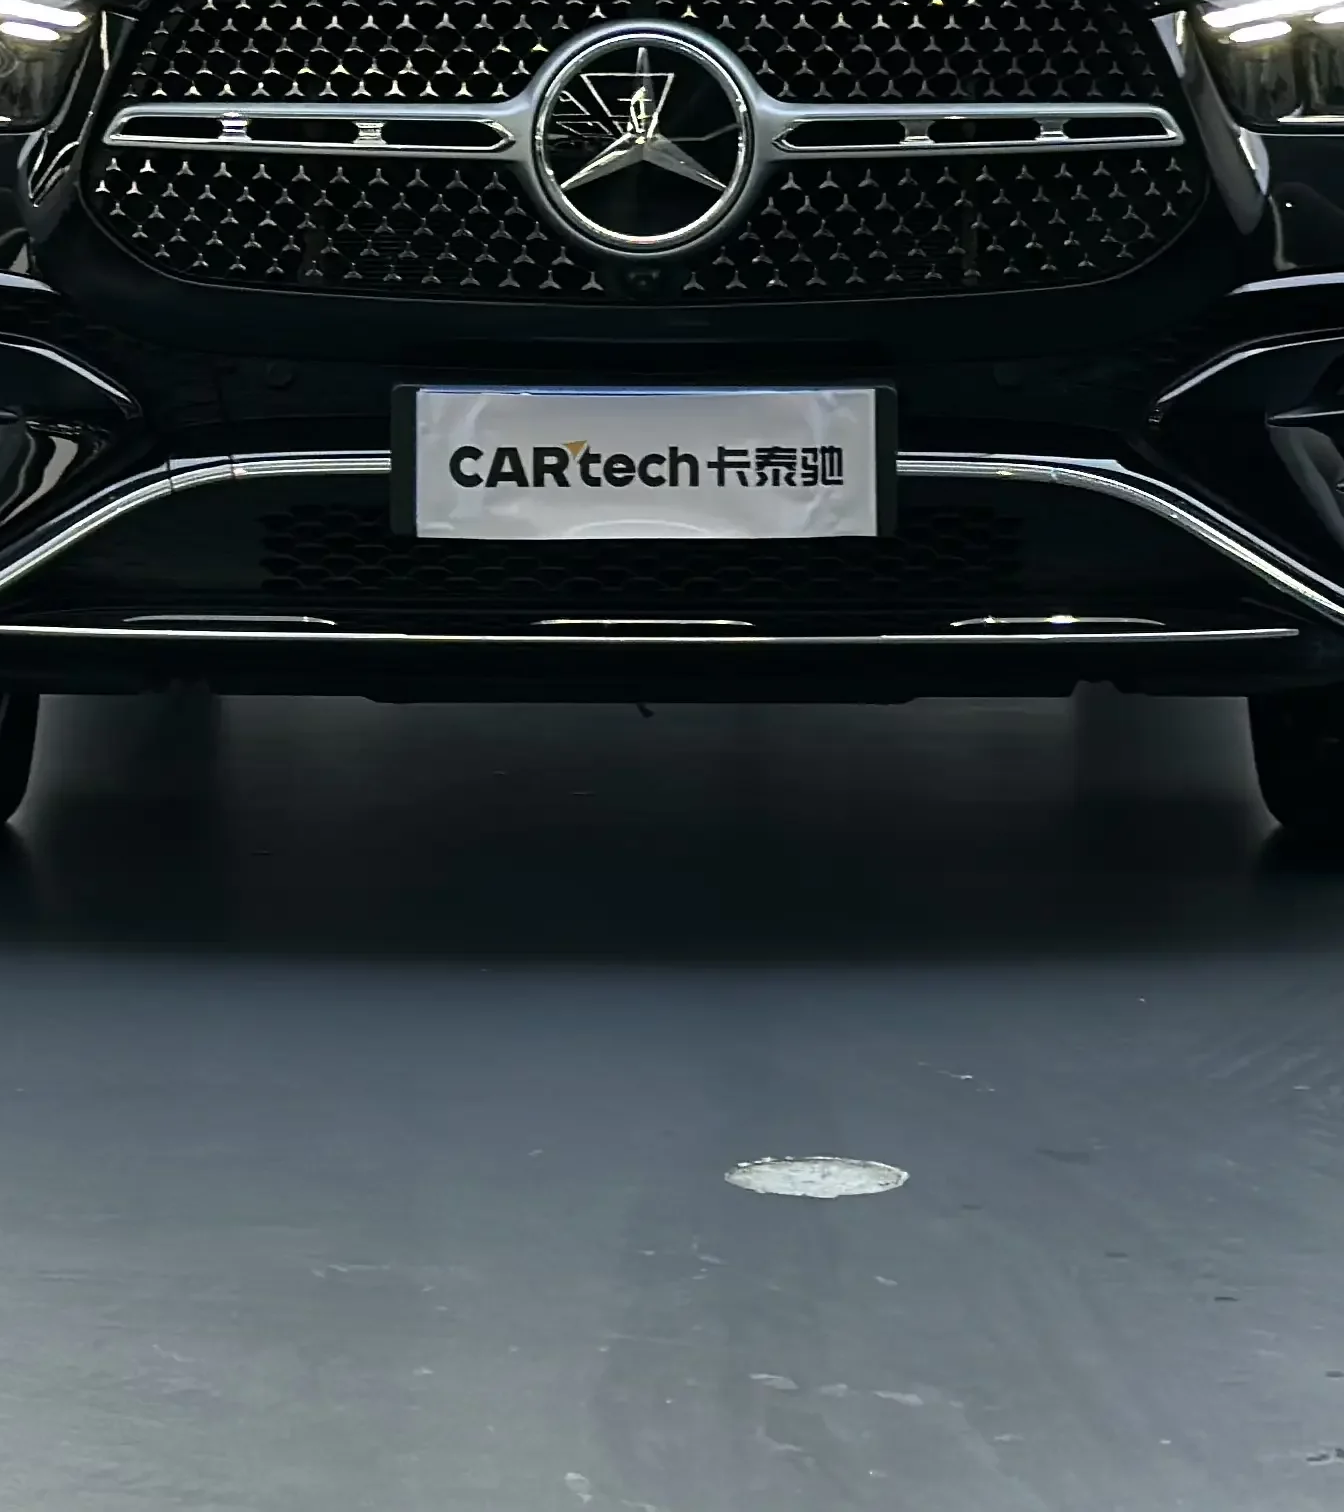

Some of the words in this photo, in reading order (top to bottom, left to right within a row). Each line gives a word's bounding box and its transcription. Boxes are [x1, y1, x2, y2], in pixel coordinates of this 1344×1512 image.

[449, 444, 699, 488] CARtech
[707, 445, 844, 487] 卡泰驰
